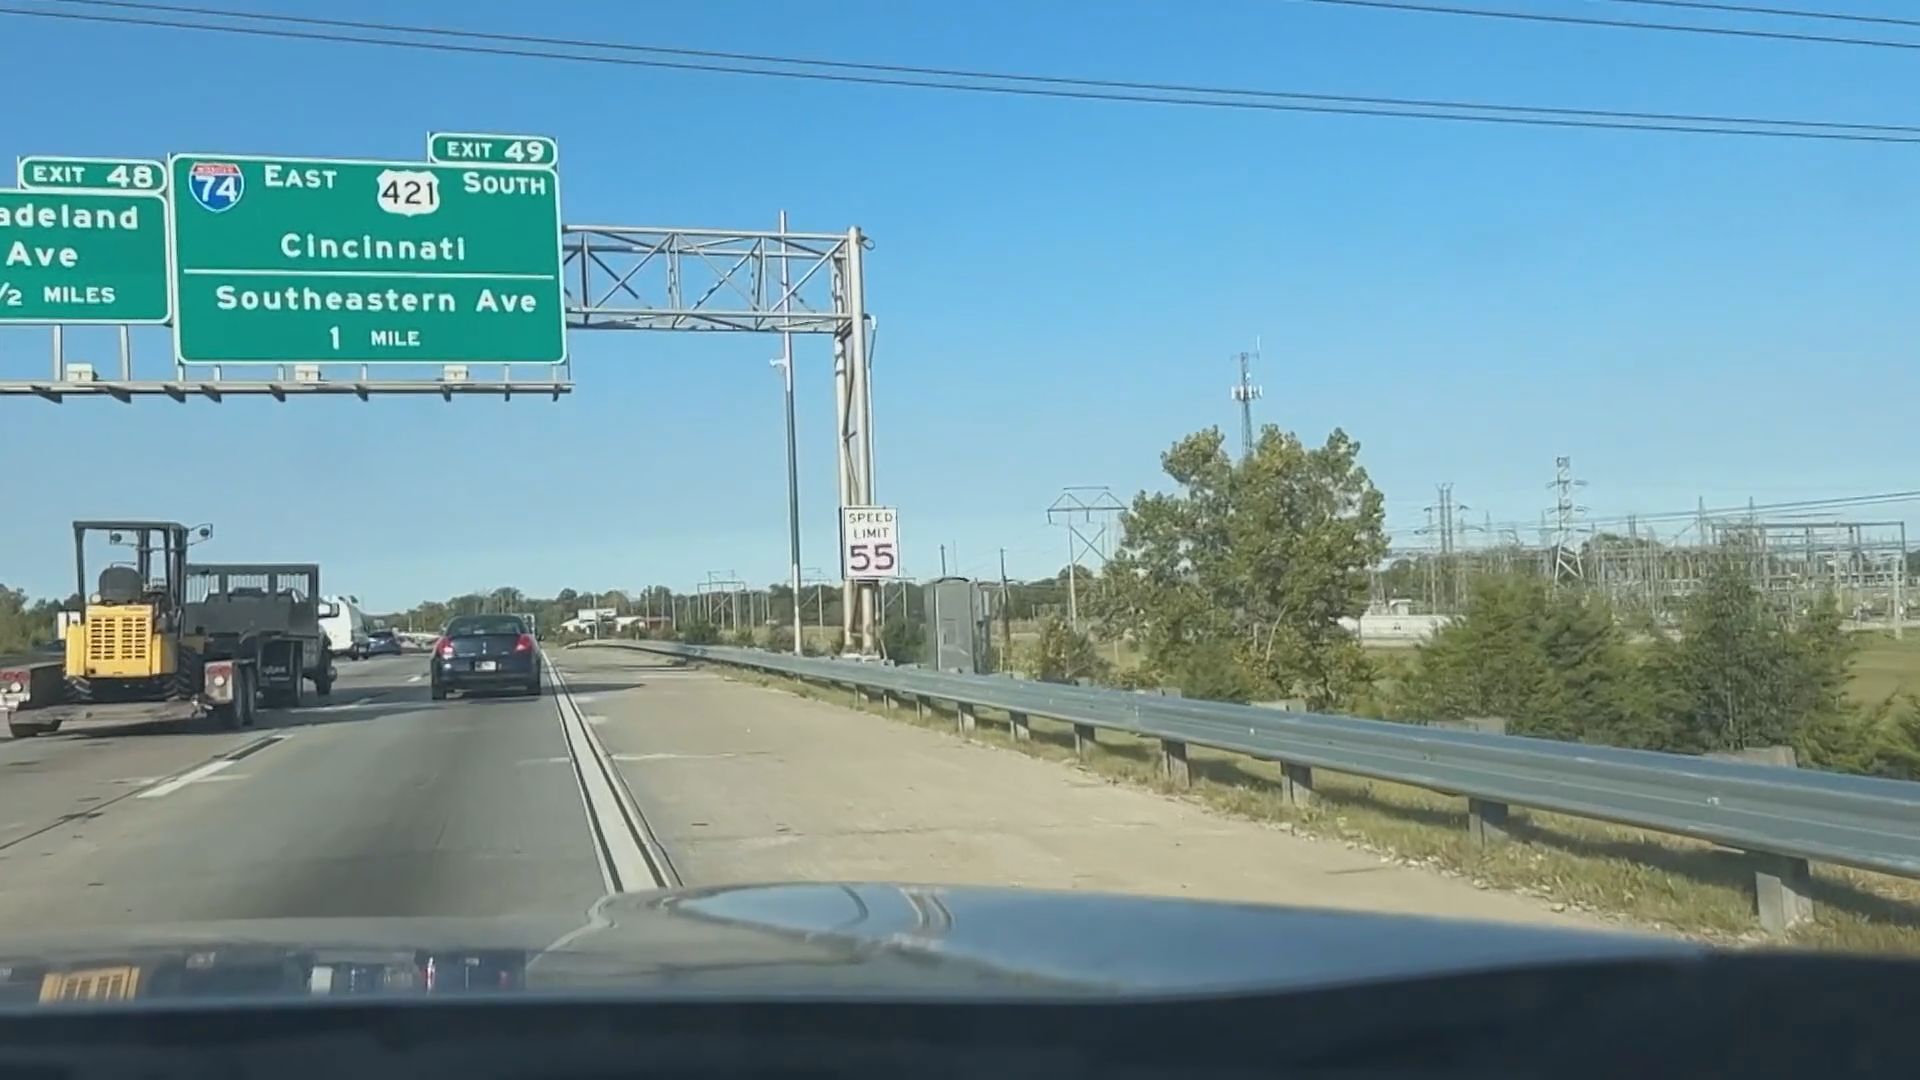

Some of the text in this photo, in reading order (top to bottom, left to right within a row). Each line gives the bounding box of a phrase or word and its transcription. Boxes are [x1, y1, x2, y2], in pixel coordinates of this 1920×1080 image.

[447, 140, 545, 163] EXIT 49
[32, 164, 154, 189] EXIT 48
[195, 164, 547, 206] 74 EAST 421 SOUTH
[5, 240, 79, 268] Ave
[280, 232, 466, 261] Cincinnati
[43, 286, 116, 304] MILES
[215, 285, 538, 313] Southeastern Ave
[329, 325, 421, 350] 1 MILE
[849, 512, 893, 524] SPEED
[853, 527, 890, 539] LIMIT
[850, 543, 895, 571] 55
